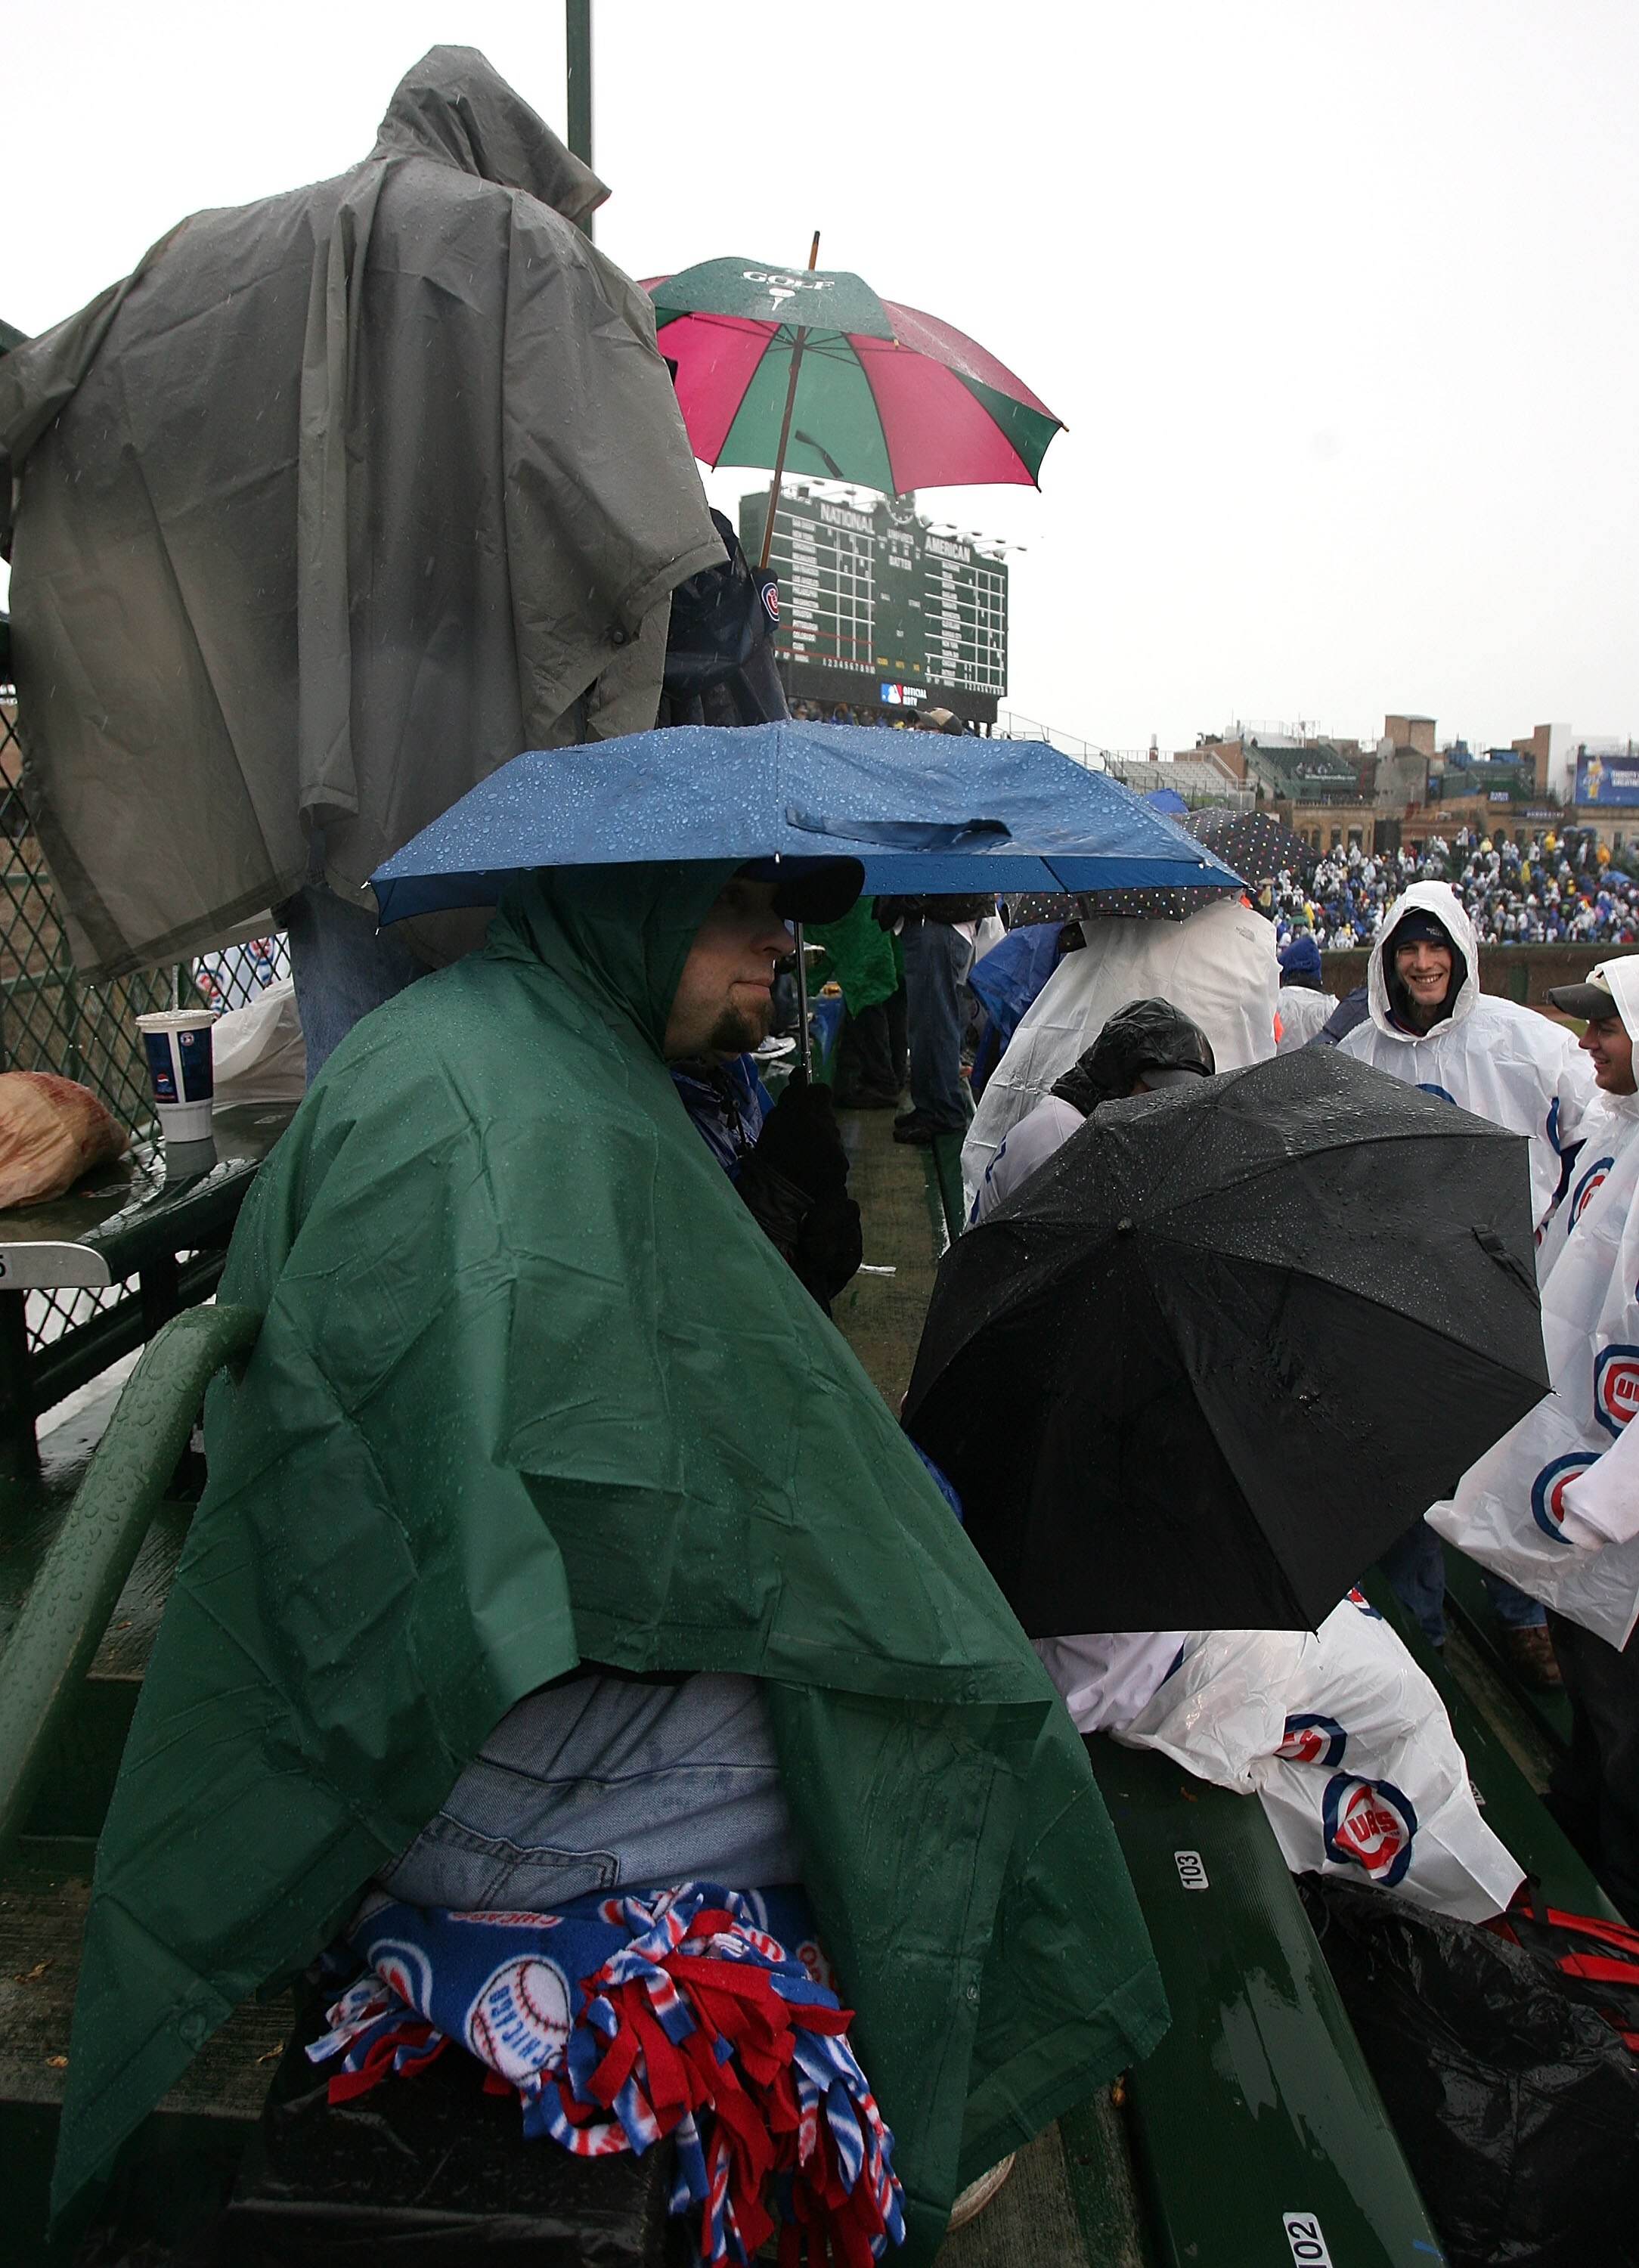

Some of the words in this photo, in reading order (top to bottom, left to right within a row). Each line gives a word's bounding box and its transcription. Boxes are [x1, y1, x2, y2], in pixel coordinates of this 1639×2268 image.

[742, 271, 835, 290] GOLF
[820, 502, 875, 534] NATIONAL
[925, 535, 971, 563] AMERICAN
[888, 554, 912, 571] BATTER
[823, 657, 826, 666] 1
[828, 658, 832, 667] 2
[834, 659, 838, 668] 3
[839, 660, 843, 669] 4
[844, 662, 848, 670] 5
[850, 662, 854, 671] 6
[854, 663, 859, 671] 7
[860, 664, 864, 672] 8
[866, 665, 869, 674] 9
[903, 686, 928, 699] OFFICIAL
[1177, 1856, 1203, 1885] 103
[488, 1983, 553, 2066] CHICAGO
